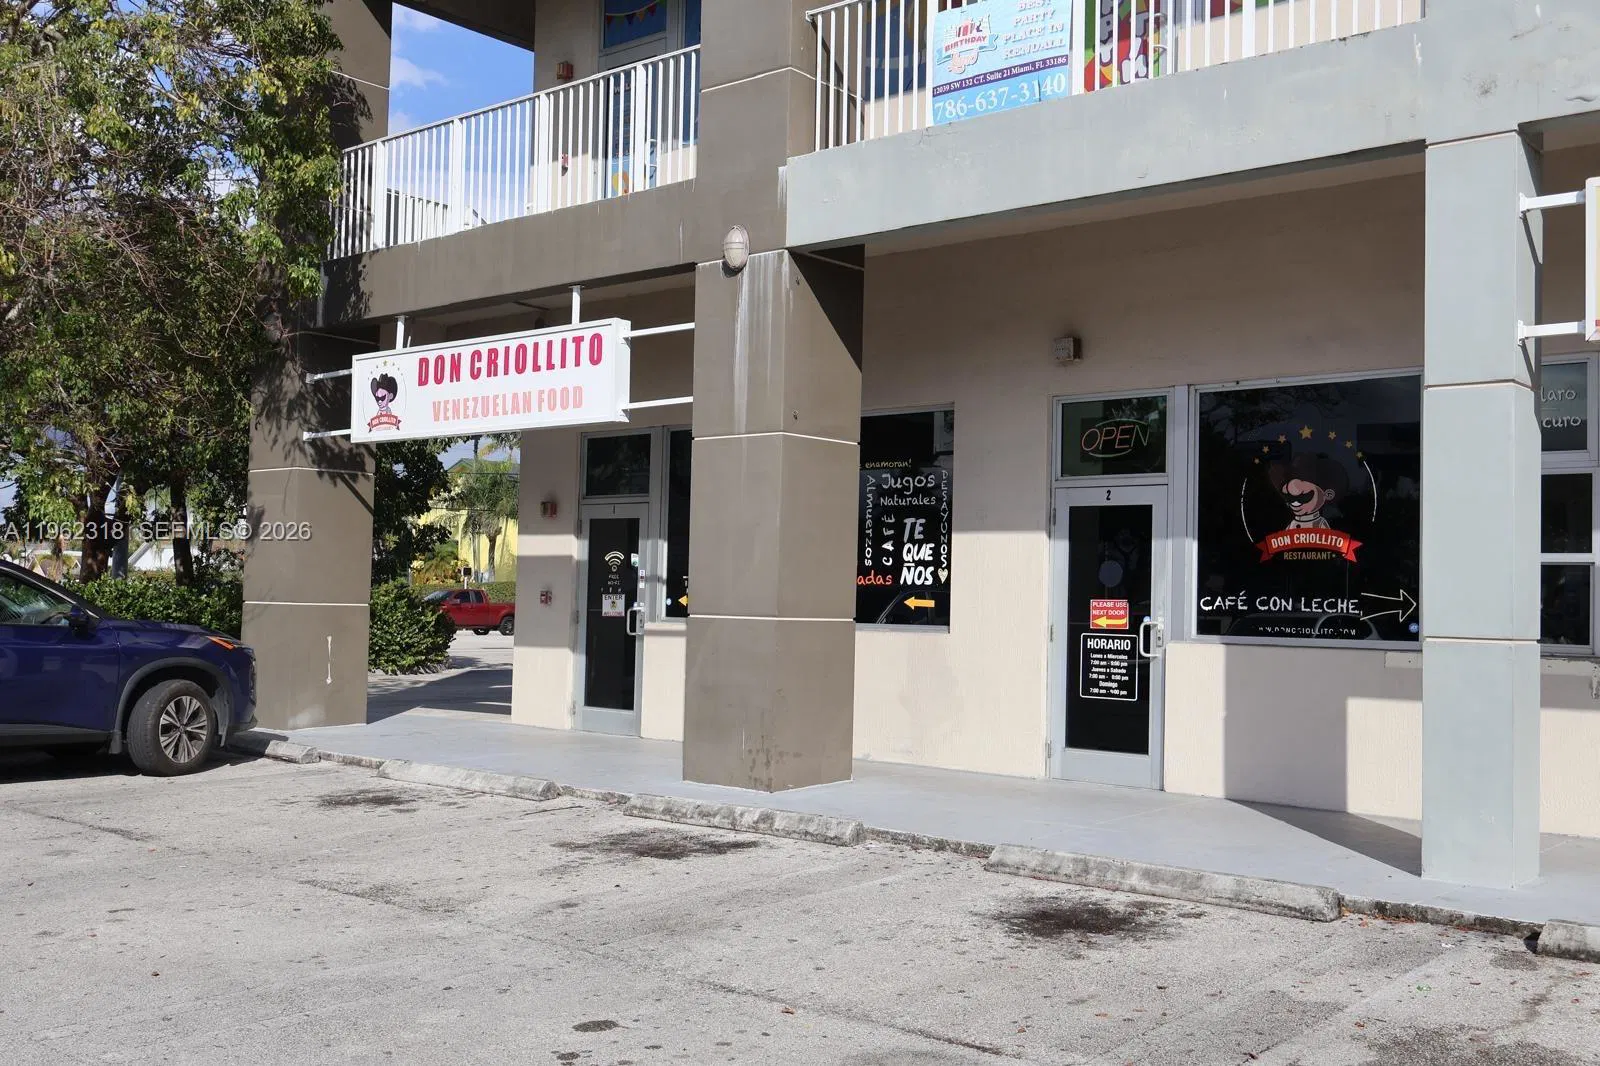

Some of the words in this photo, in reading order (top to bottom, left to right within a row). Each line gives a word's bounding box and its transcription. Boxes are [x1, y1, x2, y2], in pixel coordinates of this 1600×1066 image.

[944, 35, 987, 52] BIRTHDAY
[1046, 57, 1067, 67] 33186
[934, 72, 1066, 120] 786-637-3140
[417, 352, 462, 387] DON
[469, 332, 603, 381] CRIOLLITO
[432, 389, 532, 422] VENEZUELAN
[537, 385, 584, 412] FOOD
[1082, 425, 1150, 451] OPEN
[864, 458, 912, 469] enamoran!
[882, 473, 936, 494] Jugos
[880, 494, 936, 506] Naturales
[1106, 490, 1112, 500] 2
[940, 470, 950, 568] DESAYUNOS
[882, 514, 896, 566] CAFÉ
[904, 518, 926, 543] TE
[1271, 535, 1291, 548] DON
[1294, 533, 1344, 548] CRIOLLITO
[902, 542, 935, 562] QUE
[1284, 552, 1332, 560] RESTAURANT
[857, 570, 893, 585] adas
[900, 563, 934, 586] ÑOS
[1200, 590, 1248, 610] CAFÉ
[1256, 596, 1292, 611] CON
[1087, 638, 1131, 650] HORARIO
